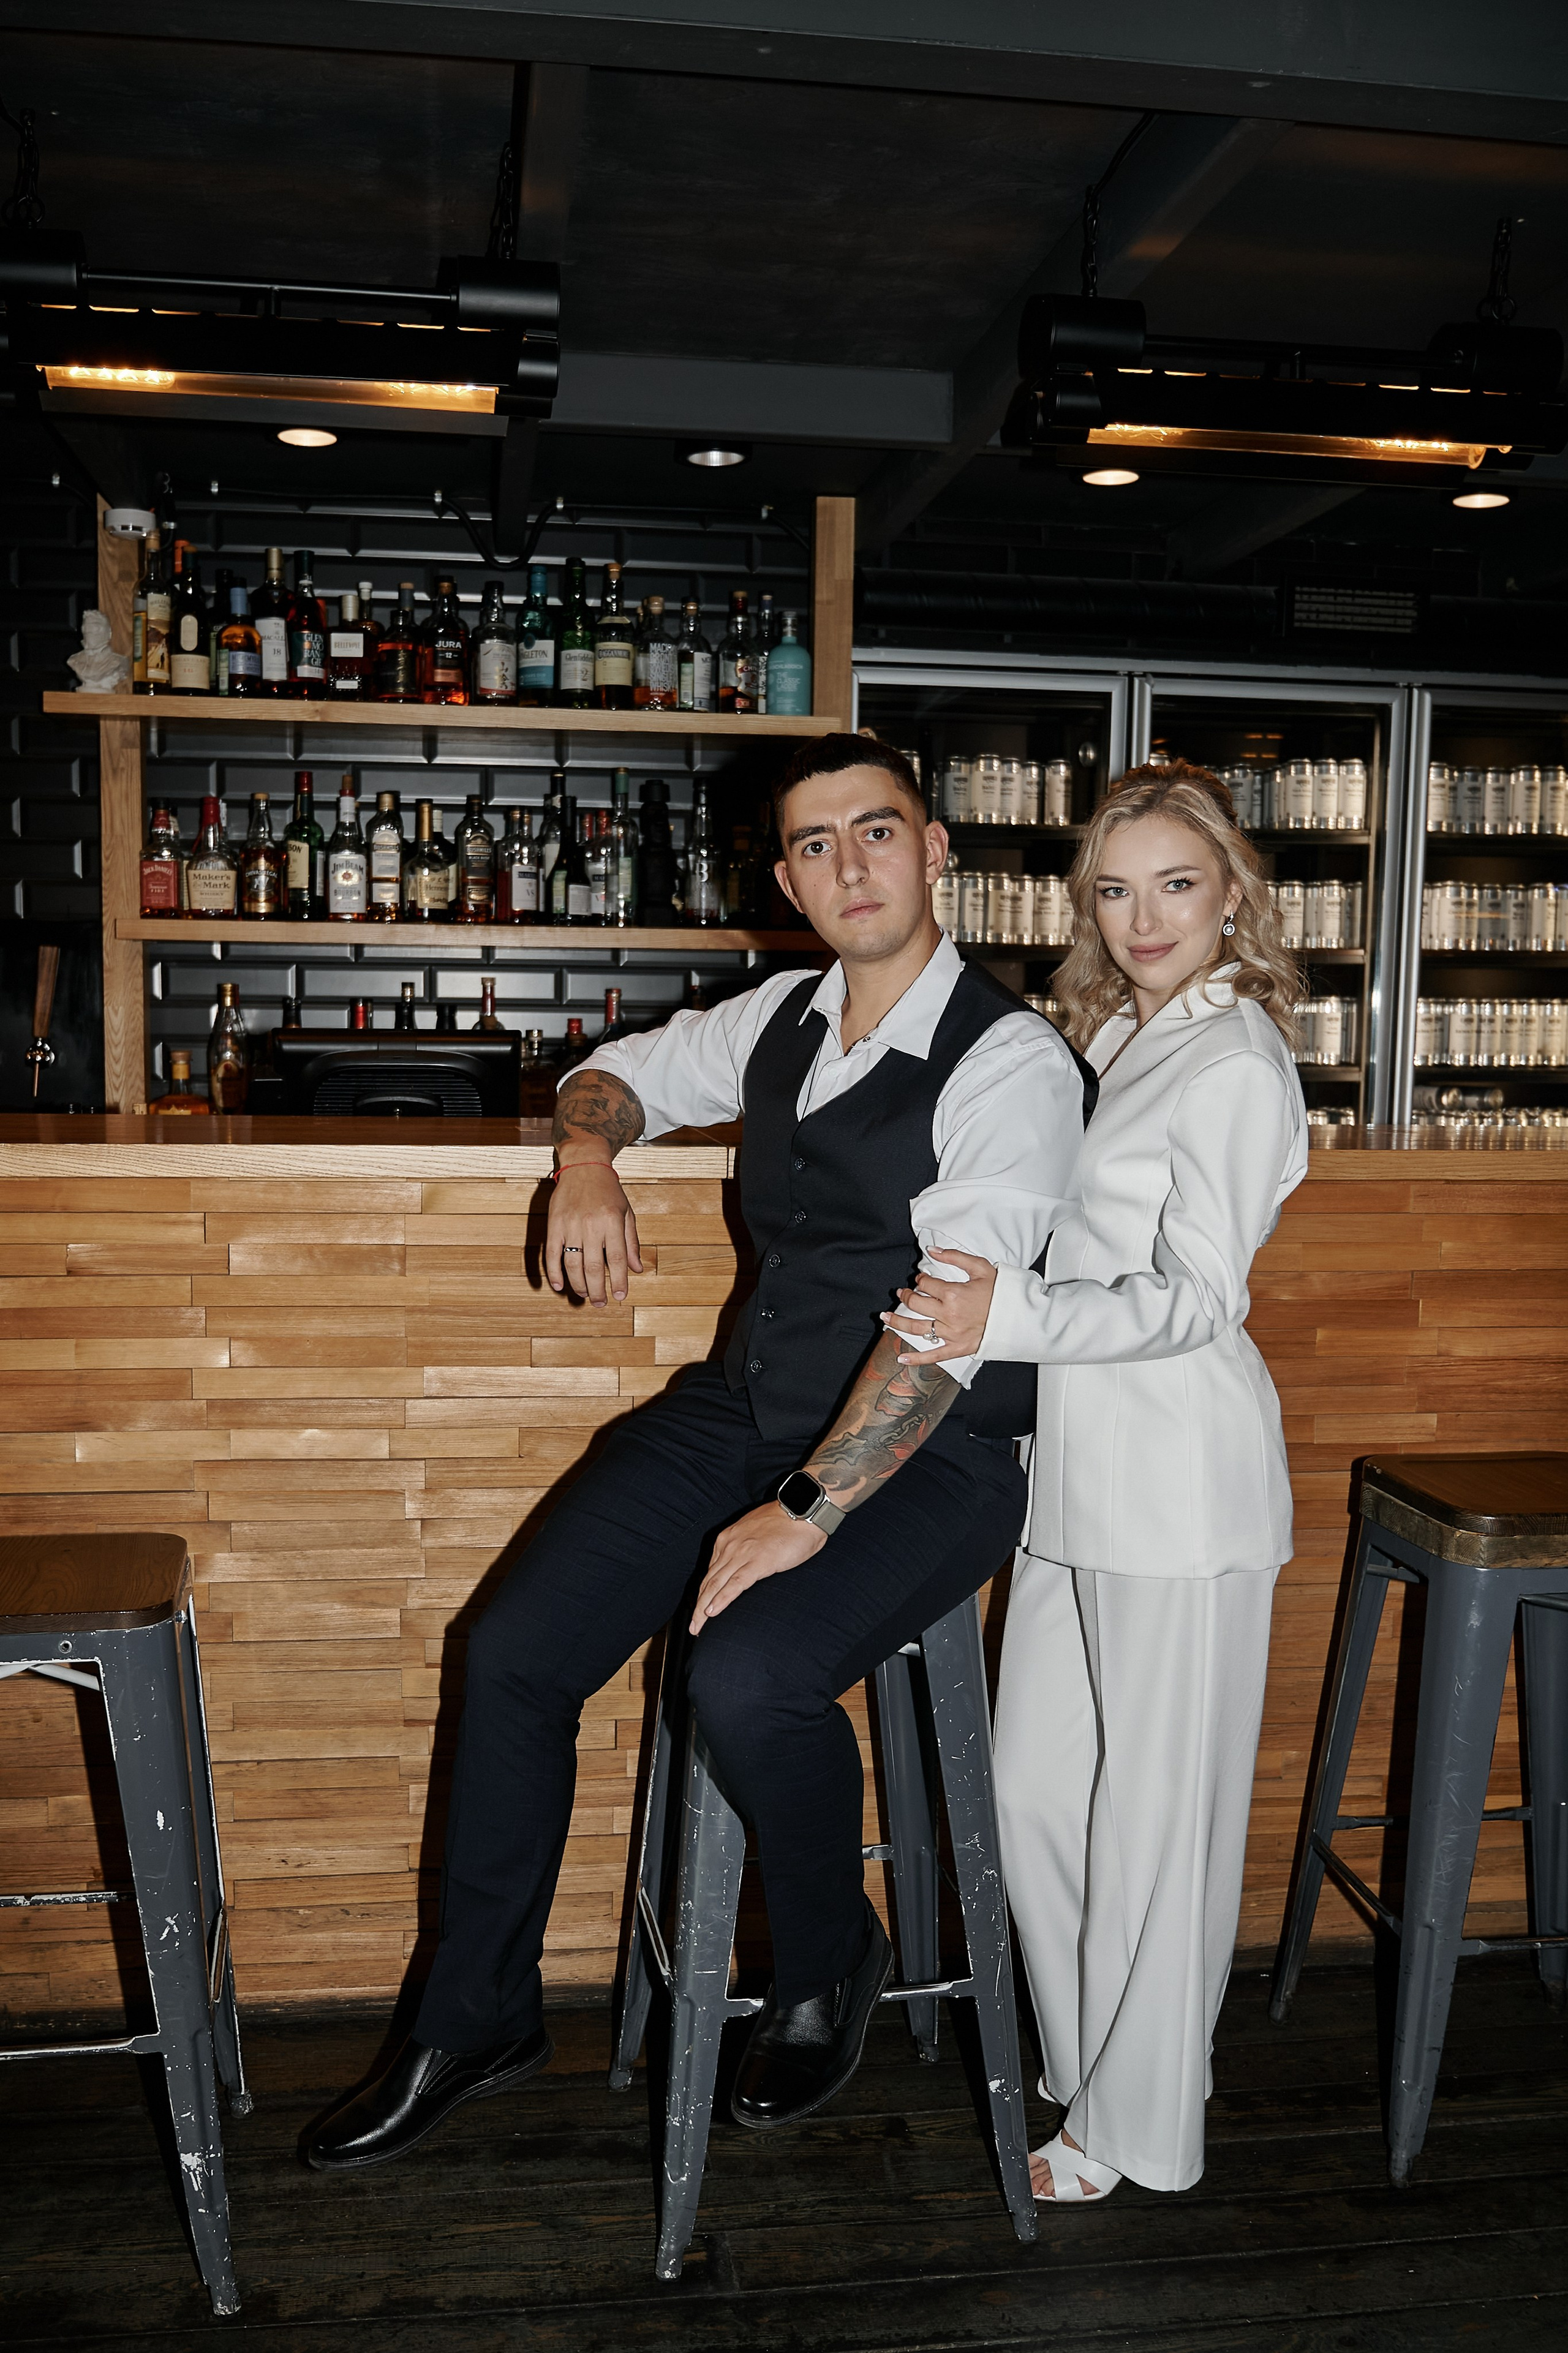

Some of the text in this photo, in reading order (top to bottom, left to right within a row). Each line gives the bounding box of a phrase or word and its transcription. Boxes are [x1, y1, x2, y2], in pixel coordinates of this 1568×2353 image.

[304, 633, 324, 642] GLEN
[312, 642, 324, 650] MO
[435, 640, 462, 649] JURA
[143, 865, 154, 876] JACK
[331, 860, 364, 875] JIM BEAM
